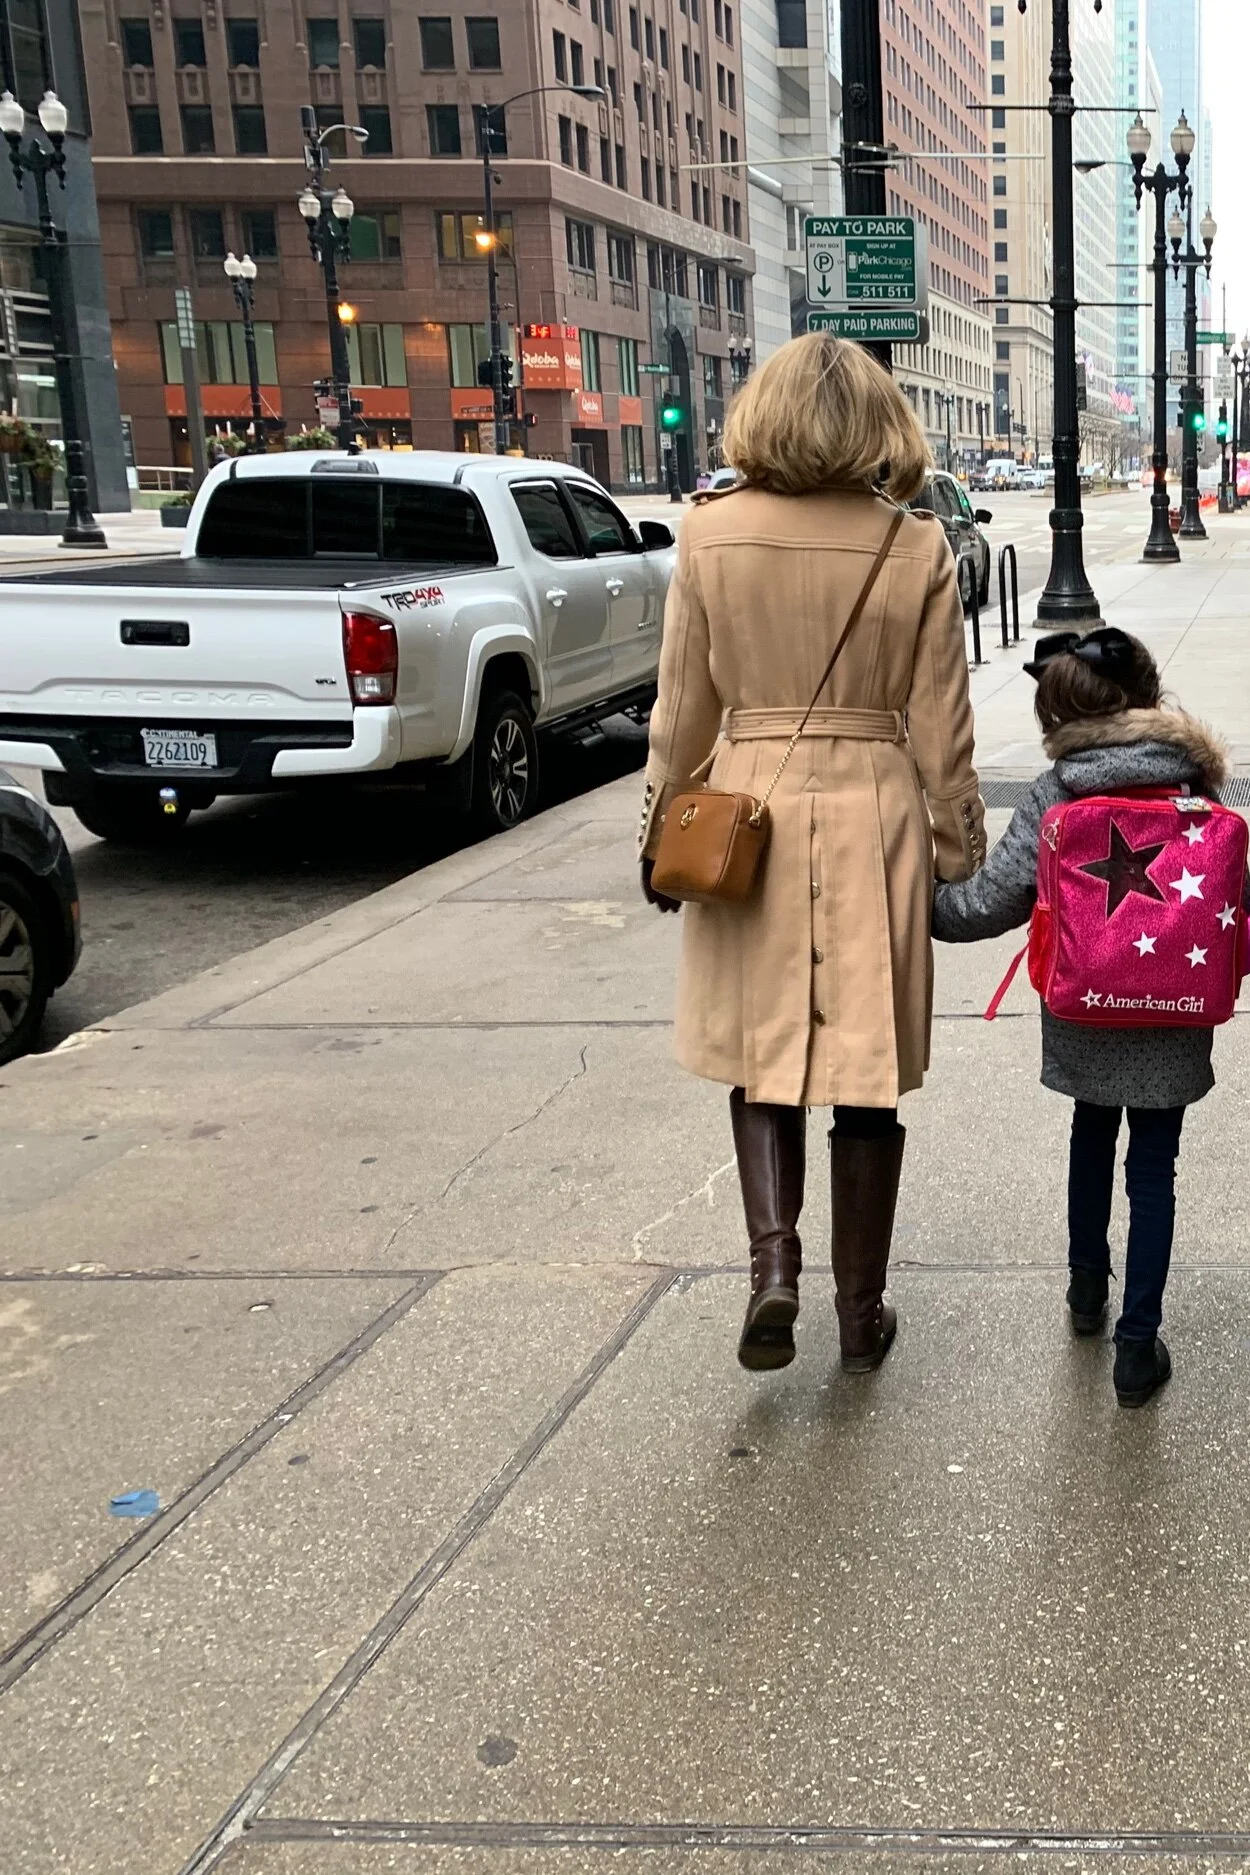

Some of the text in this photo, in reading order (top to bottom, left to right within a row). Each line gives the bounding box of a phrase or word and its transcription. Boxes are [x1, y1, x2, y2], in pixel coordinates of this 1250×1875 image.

[813, 221, 906, 234] PAY TO PARK
[858, 255, 912, 266] ParkChicago
[862, 286, 884, 297] 511
[887, 286, 909, 297] 511
[811, 318, 915, 331] 7 DAY PAID PARKING
[64, 688, 275, 707] TACOMA
[147, 741, 207, 762] 2262109
[1102, 993, 1205, 1013] American Girl
